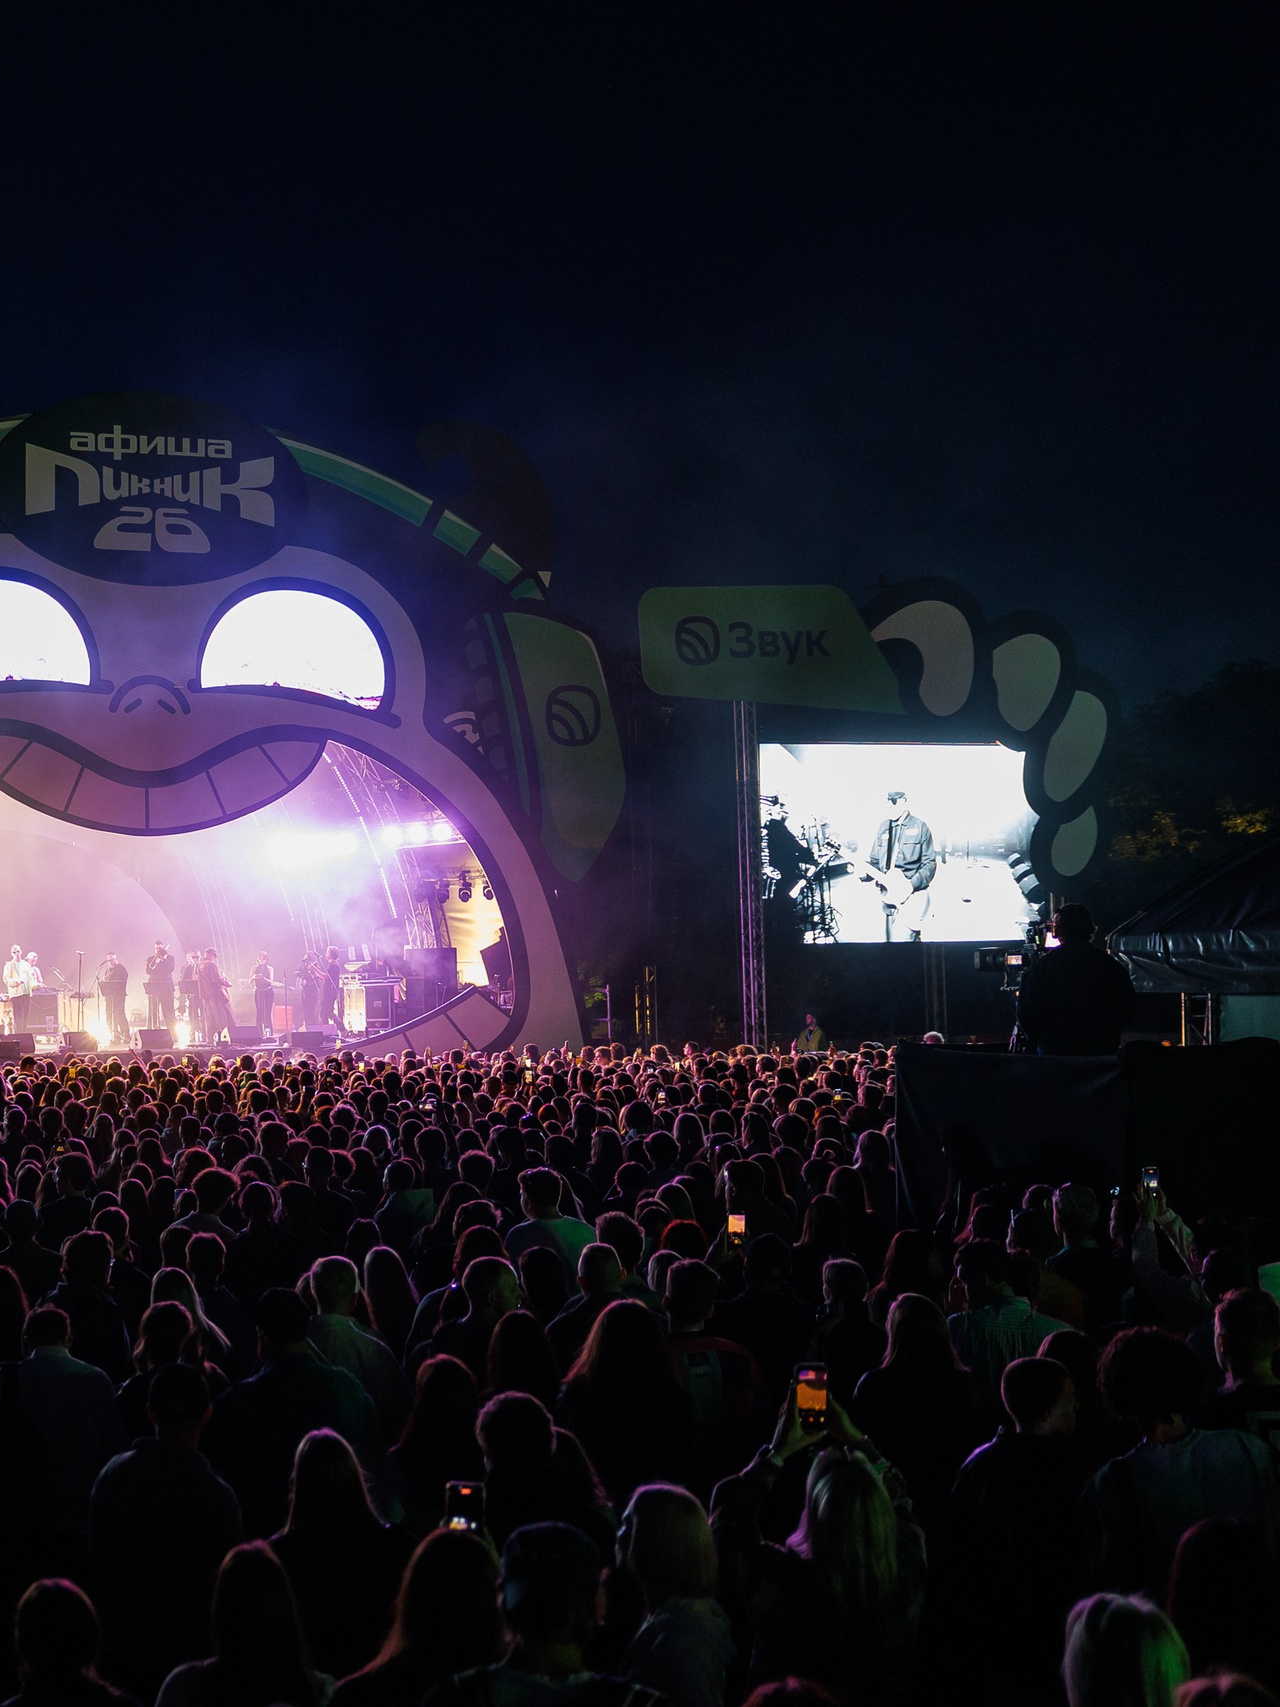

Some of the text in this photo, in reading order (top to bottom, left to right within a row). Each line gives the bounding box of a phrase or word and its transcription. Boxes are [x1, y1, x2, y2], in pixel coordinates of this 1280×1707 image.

[70, 424, 233, 461] афиша
[93, 505, 211, 554] 26
[728, 621, 830, 665] Звук
